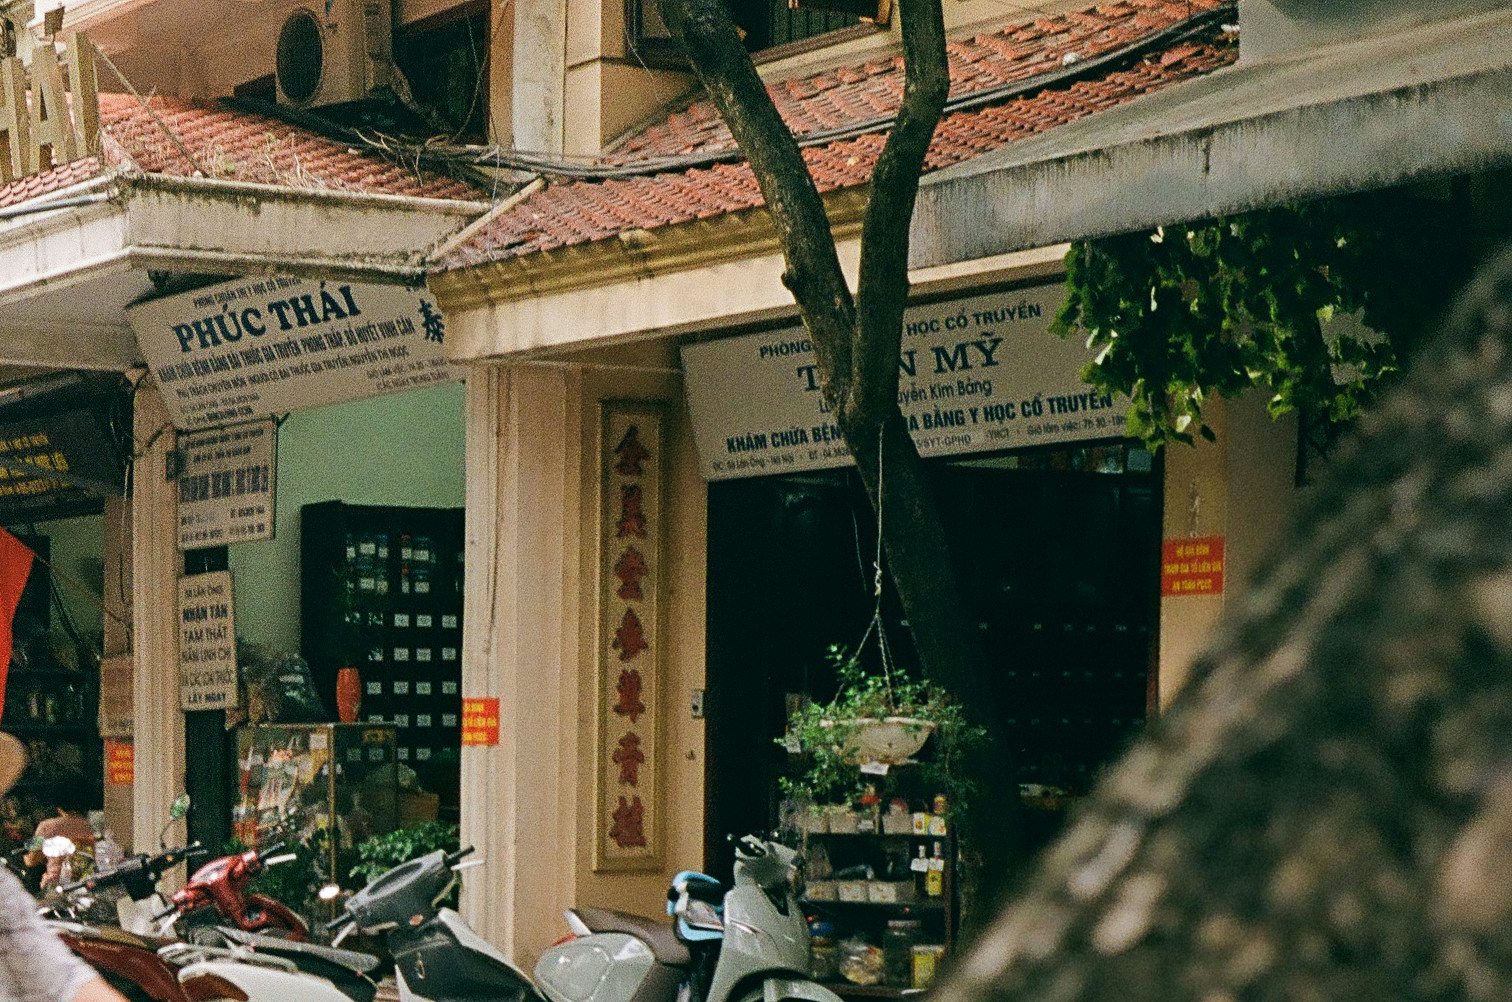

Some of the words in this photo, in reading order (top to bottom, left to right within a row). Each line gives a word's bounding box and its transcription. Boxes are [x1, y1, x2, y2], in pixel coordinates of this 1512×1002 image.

[173, 303, 266, 352] PHÚC
[268, 281, 362, 331] THÁI
[906, 318, 940, 338] HỌC
[944, 306, 969, 330] CỔ
[972, 299, 1042, 326] TRUYỀN
[930, 330, 1004, 375] MỸ
[929, 383, 956, 400] Kim
[726, 431, 768, 454] KHÁM
[771, 424, 809, 449] CHỮA
[811, 422, 843, 447] BỆN
[923, 402, 966, 429] BẰNG
[968, 406, 980, 424] Y
[983, 403, 1016, 427] HỌC
[1020, 391, 1045, 418] CỔ
